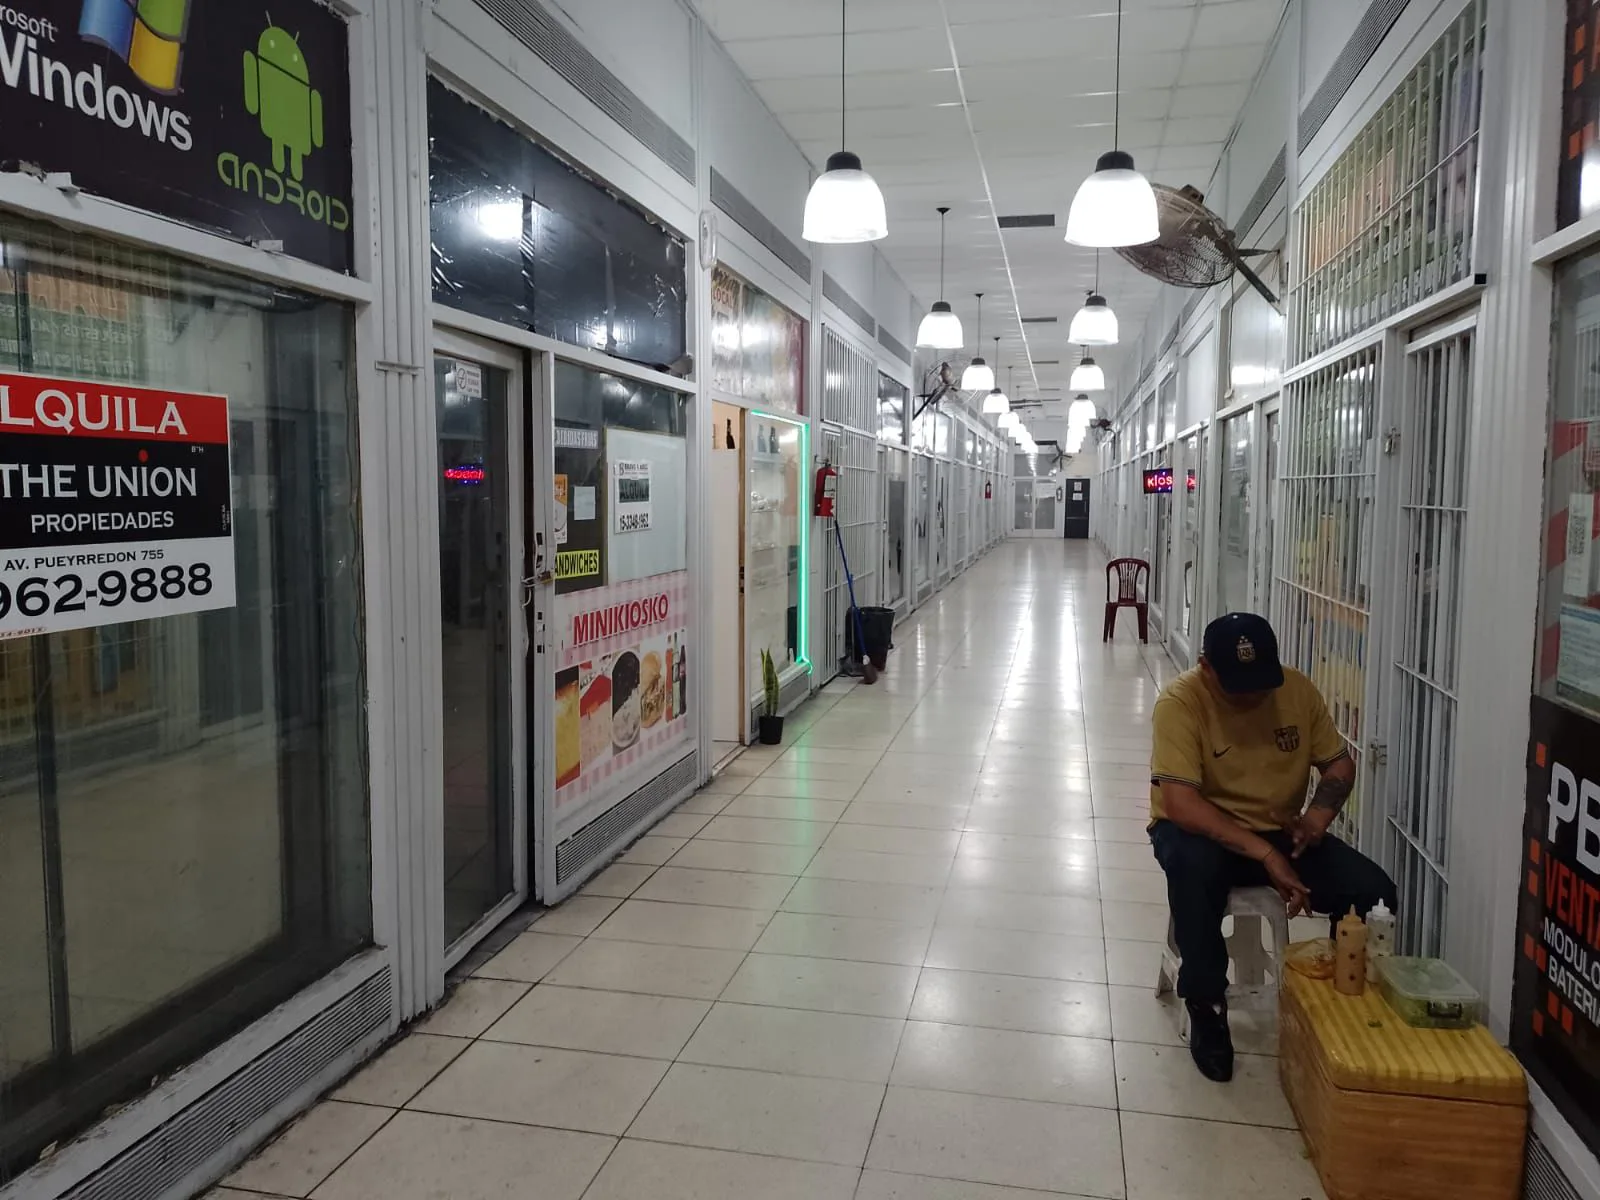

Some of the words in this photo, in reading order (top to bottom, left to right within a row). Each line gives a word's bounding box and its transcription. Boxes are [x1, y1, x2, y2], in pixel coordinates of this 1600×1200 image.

[0, 4, 56, 43] rosoft
[0, 385, 188, 434] LQUILA
[0, 463, 78, 498] THE
[87, 464, 197, 498] UNION
[31, 511, 174, 533] PROPIEDADES
[4, 559, 29, 572] AV.
[34, 551, 137, 569] PUEYRREDON
[141, 549, 164, 561] 755
[573, 593, 669, 646] MINIKIOSKO
